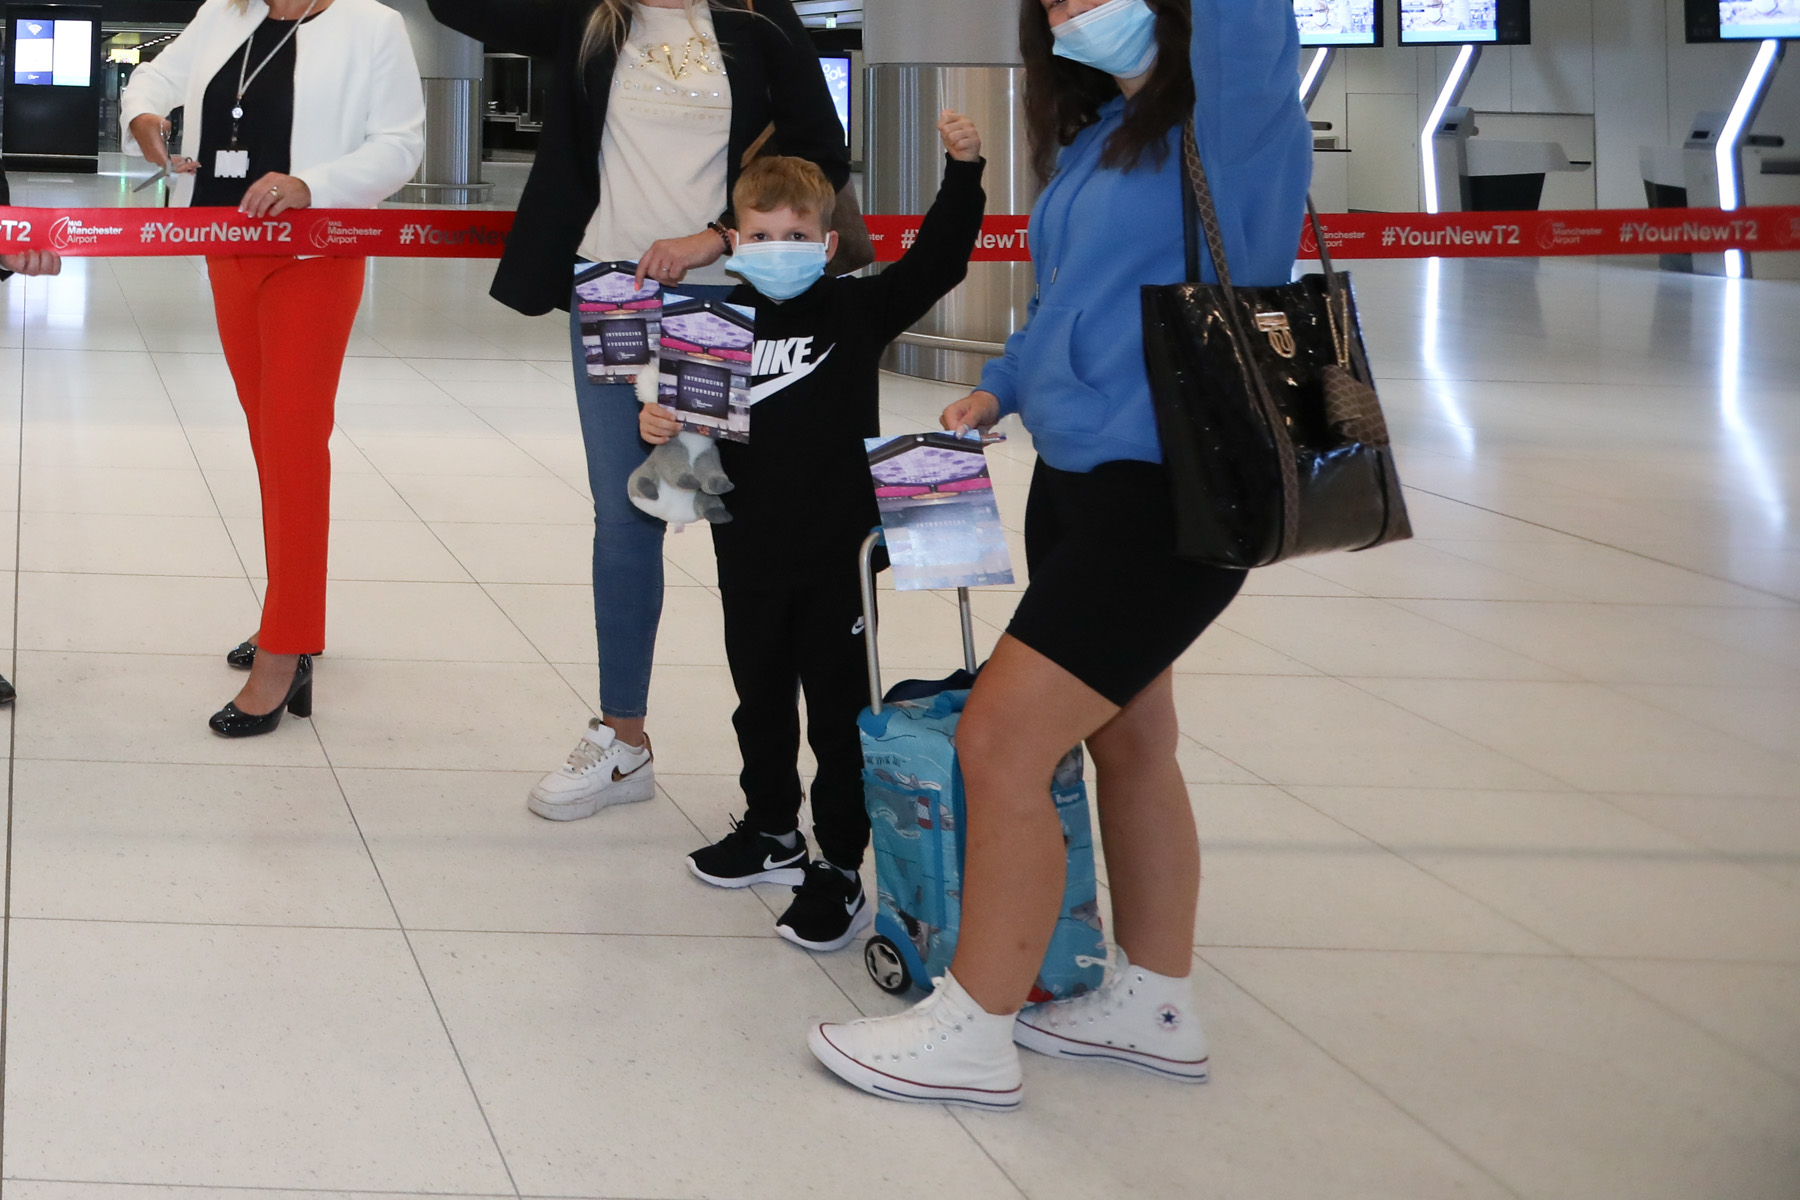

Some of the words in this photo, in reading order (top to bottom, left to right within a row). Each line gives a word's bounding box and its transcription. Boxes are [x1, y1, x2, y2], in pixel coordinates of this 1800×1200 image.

[67, 226, 123, 236] Manchester
[140, 221, 292, 243] #YourNewT2
[327, 226, 382, 236] Manchester
[1322, 230, 1366, 239] anchester
[1381, 225, 1520, 247] #YourNewT2
[1619, 220, 1758, 243] #YourNewT2
[66, 234, 97, 244] Airport
[327, 235, 357, 244] Airport
[684, 374, 724, 387] INTRODUCING
